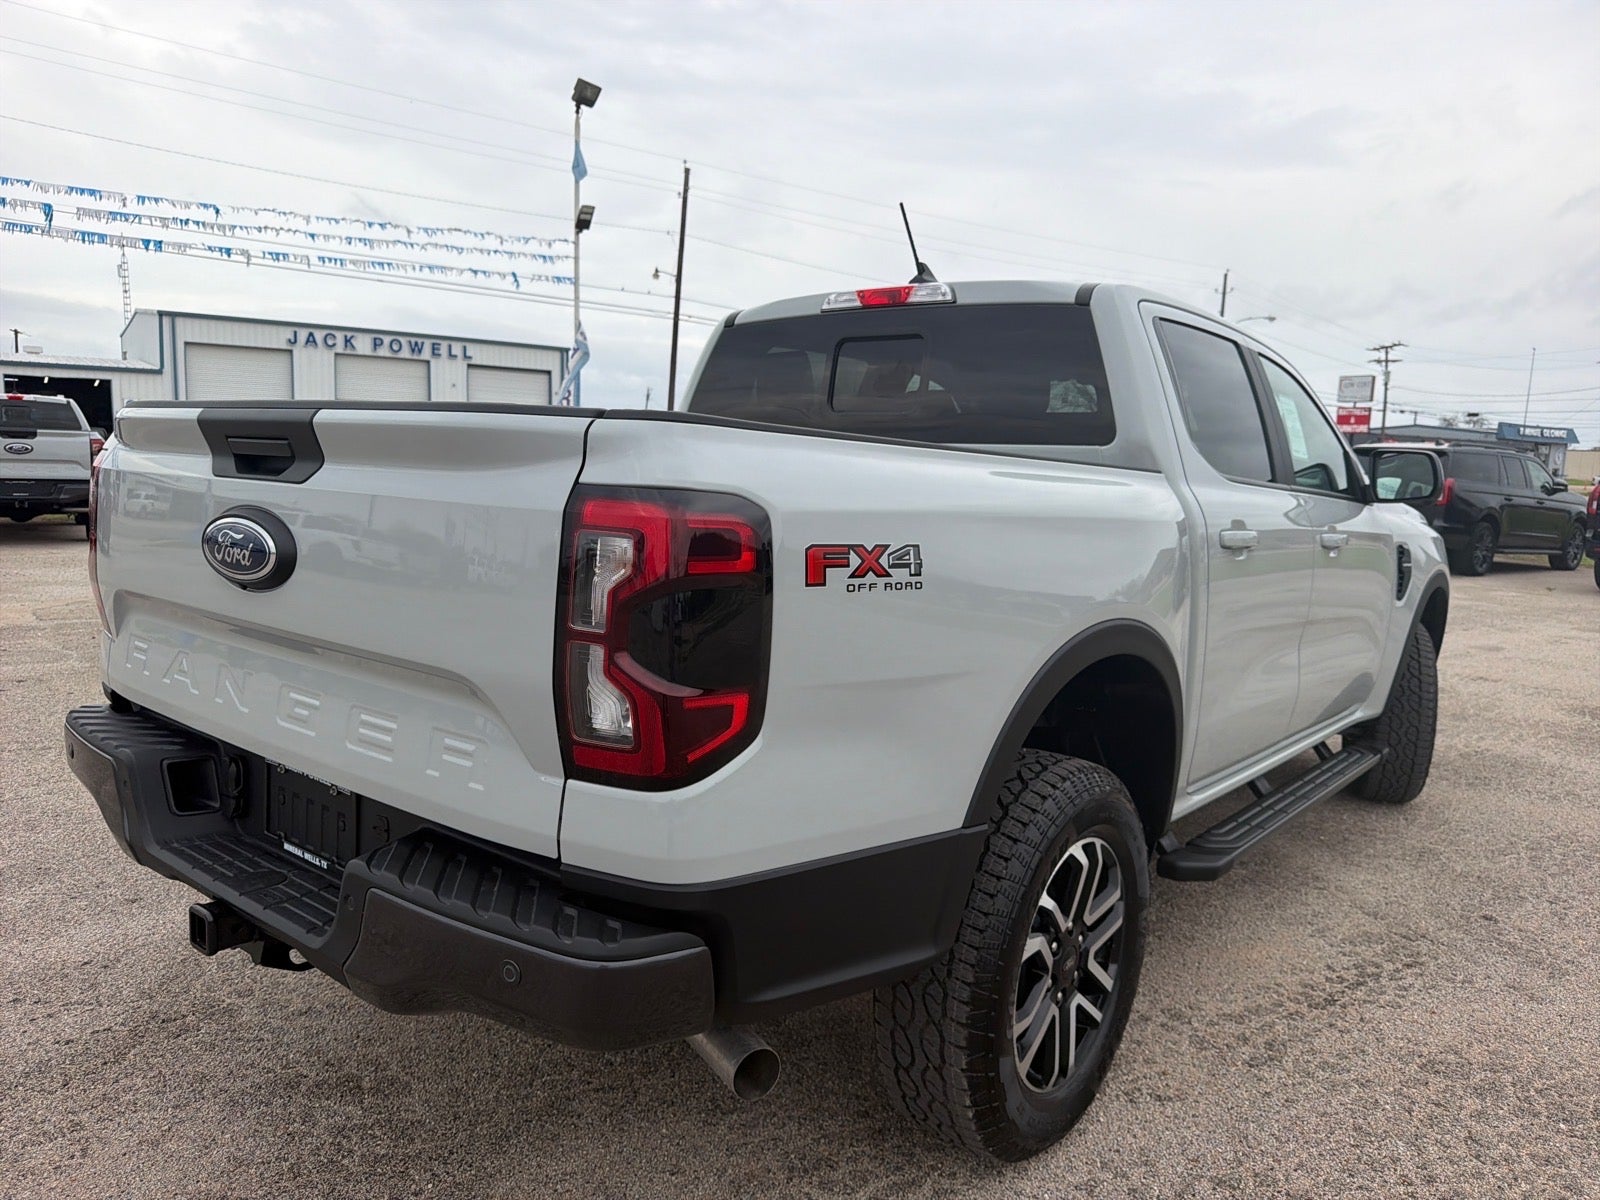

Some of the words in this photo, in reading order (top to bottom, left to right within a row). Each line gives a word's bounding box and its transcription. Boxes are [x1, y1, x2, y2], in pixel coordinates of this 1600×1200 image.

[288, 330, 357, 350] JACK
[373, 336, 473, 360] POWELL
[214, 529, 254, 567] Ford
[805, 544, 923, 587] FX4
[846, 583, 878, 593] OFF
[884, 581, 923, 592] ROAD
[125, 633, 490, 791] RANGER
